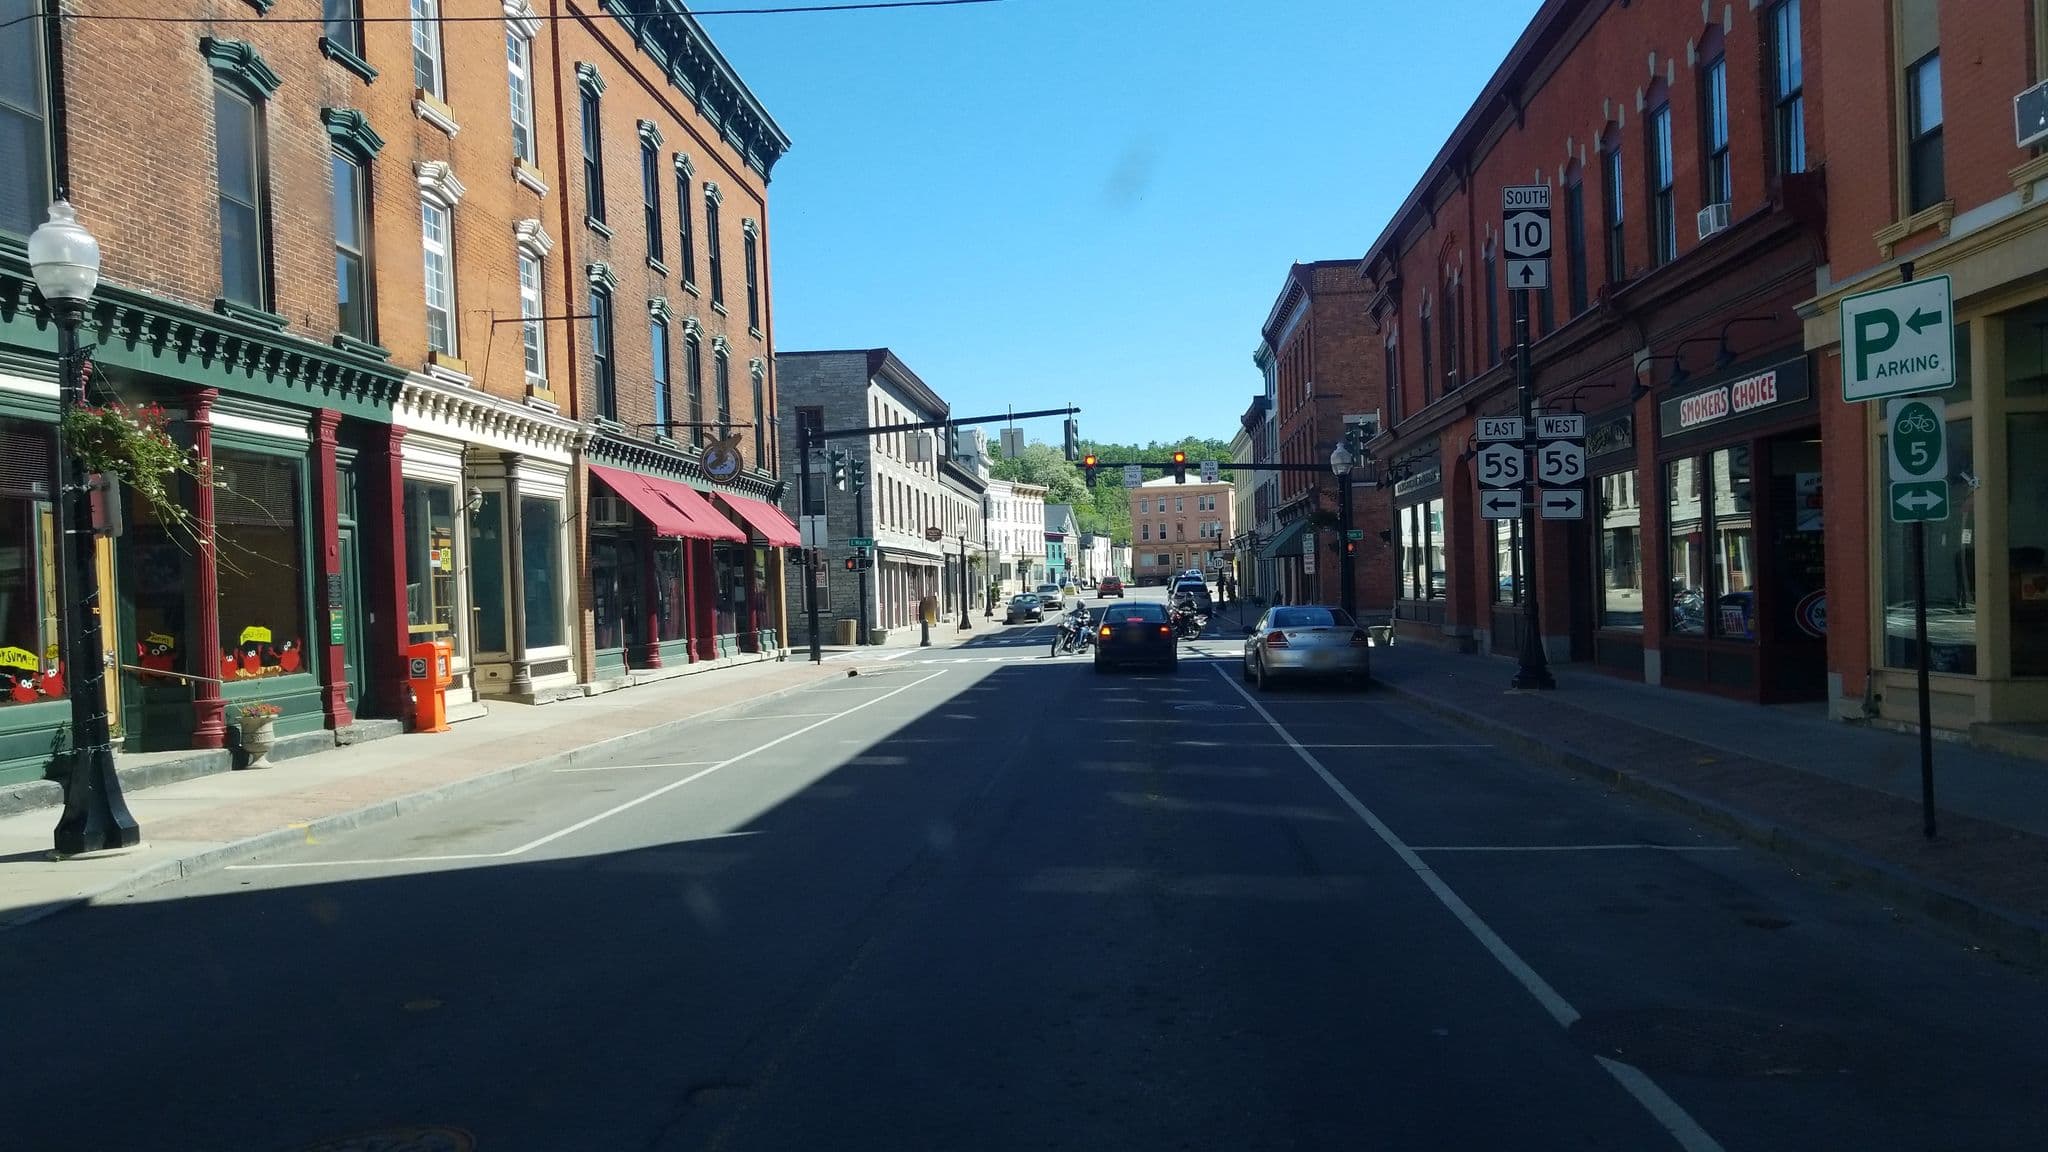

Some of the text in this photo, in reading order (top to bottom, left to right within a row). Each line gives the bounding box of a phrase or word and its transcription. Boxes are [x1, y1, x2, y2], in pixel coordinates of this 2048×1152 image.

[1505, 190, 1549, 205] SOUTH
[1513, 221, 1543, 248] 10
[1854, 307, 1940, 382] PARKING
[1680, 374, 1776, 425] SMOKERS CHOICE
[1484, 421, 1516, 437] EAST
[1543, 419, 1578, 434] WEST
[1485, 452, 1519, 479] 5S
[1545, 450, 1580, 477] 5S
[1911, 441, 1929, 468] 5
[1215, 559, 1223, 567] 10
